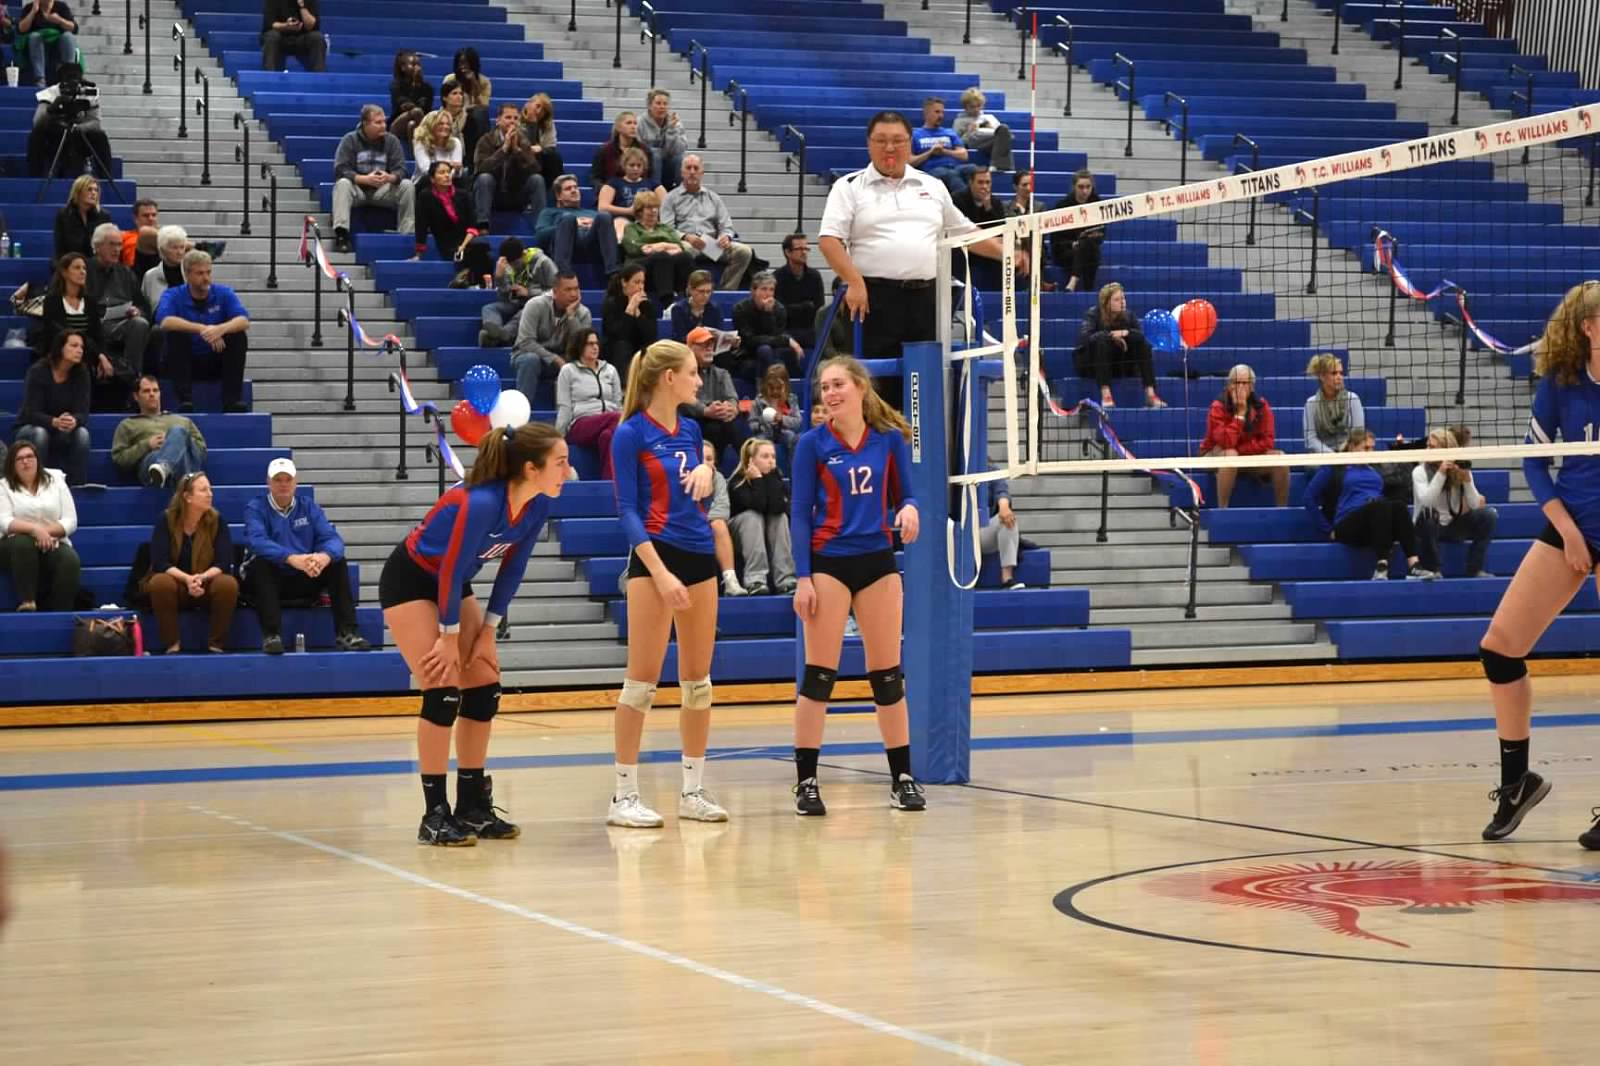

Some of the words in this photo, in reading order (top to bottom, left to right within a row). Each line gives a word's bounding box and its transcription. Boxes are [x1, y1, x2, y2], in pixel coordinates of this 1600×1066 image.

[1099, 201, 1133, 220] TITANS
[1176, 189, 1211, 205] WILLIAMS
[1240, 173, 1280, 196] TITANS
[1312, 167, 1329, 178] T.C.
[1331, 157, 1373, 175] WILLIAMS
[1408, 138, 1456, 163] TITANS
[1496, 131, 1516, 145] T.C.
[1517, 120, 1569, 142] WILLIAMS
[674, 451, 690, 478] 2
[848, 466, 873, 495] 12
